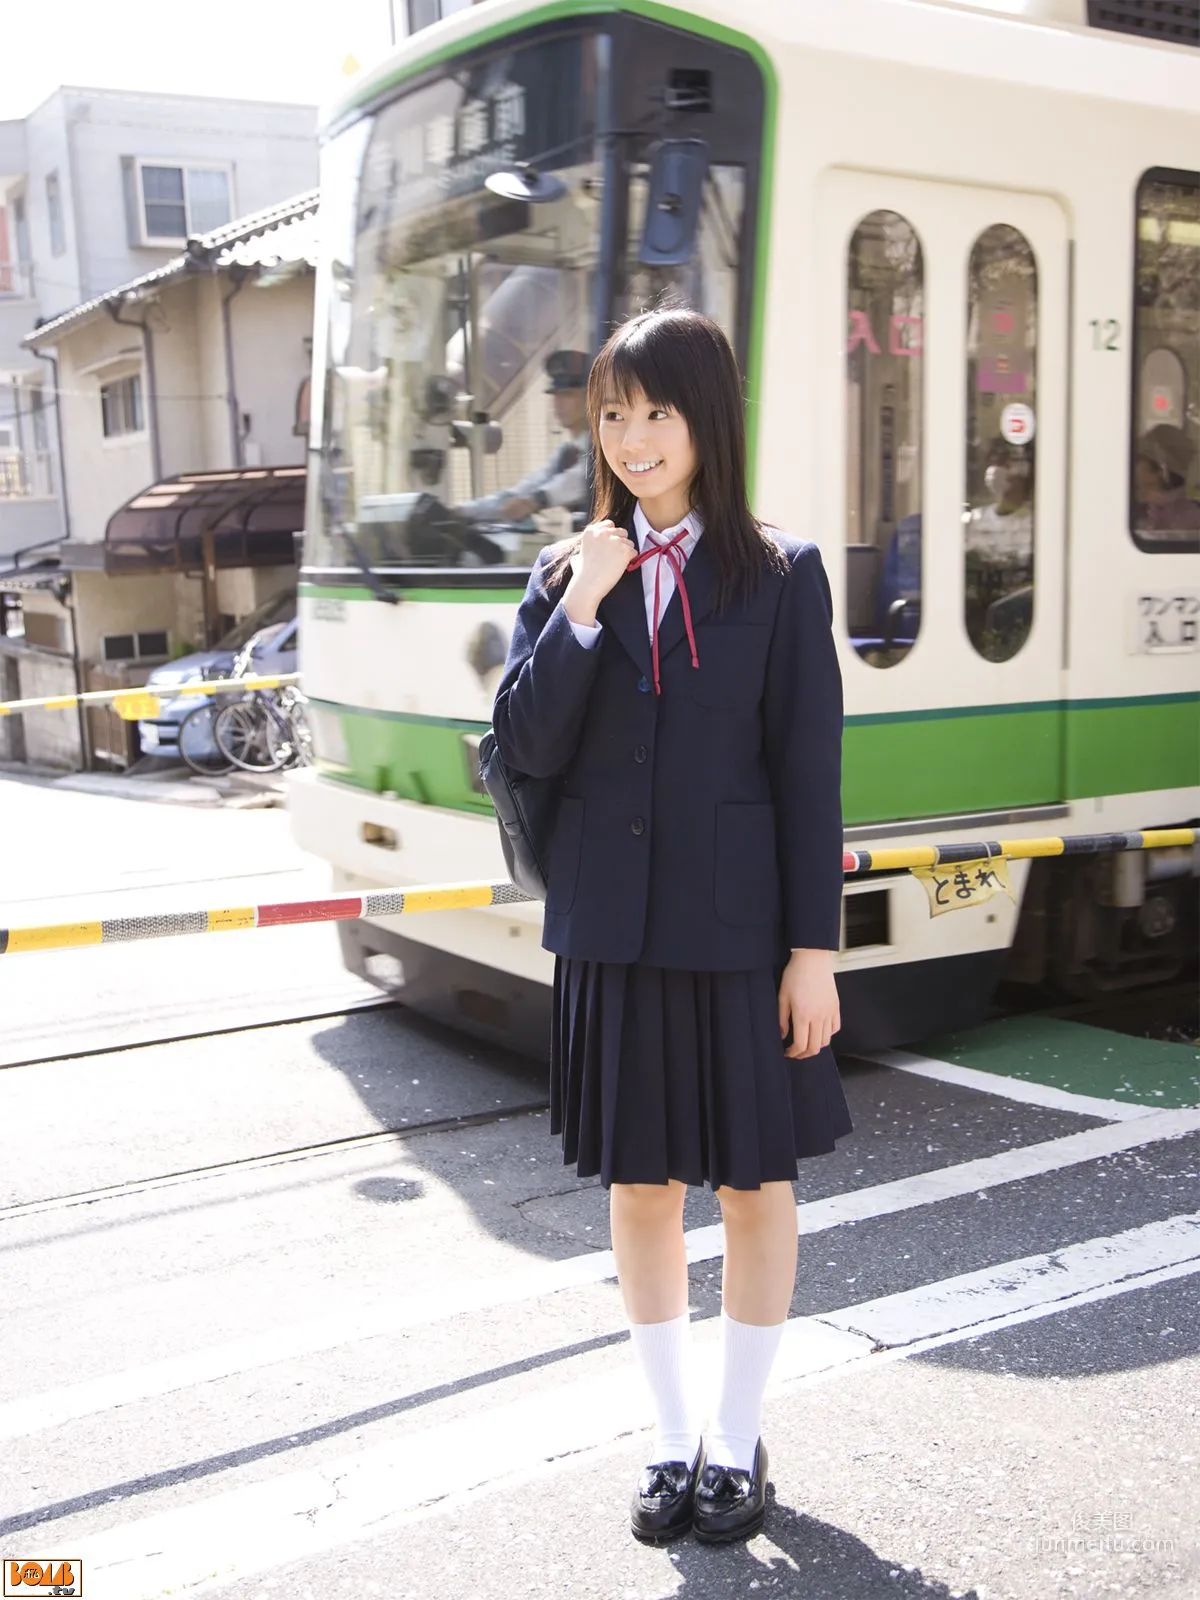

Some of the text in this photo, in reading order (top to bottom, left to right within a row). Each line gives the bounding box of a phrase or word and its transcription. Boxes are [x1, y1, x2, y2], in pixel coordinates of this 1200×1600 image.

[846, 310, 923, 356] 入口
[1088, 318, 1121, 351] 12
[1144, 620, 1197, 644] 入口
[932, 868, 1006, 905] とまれ
